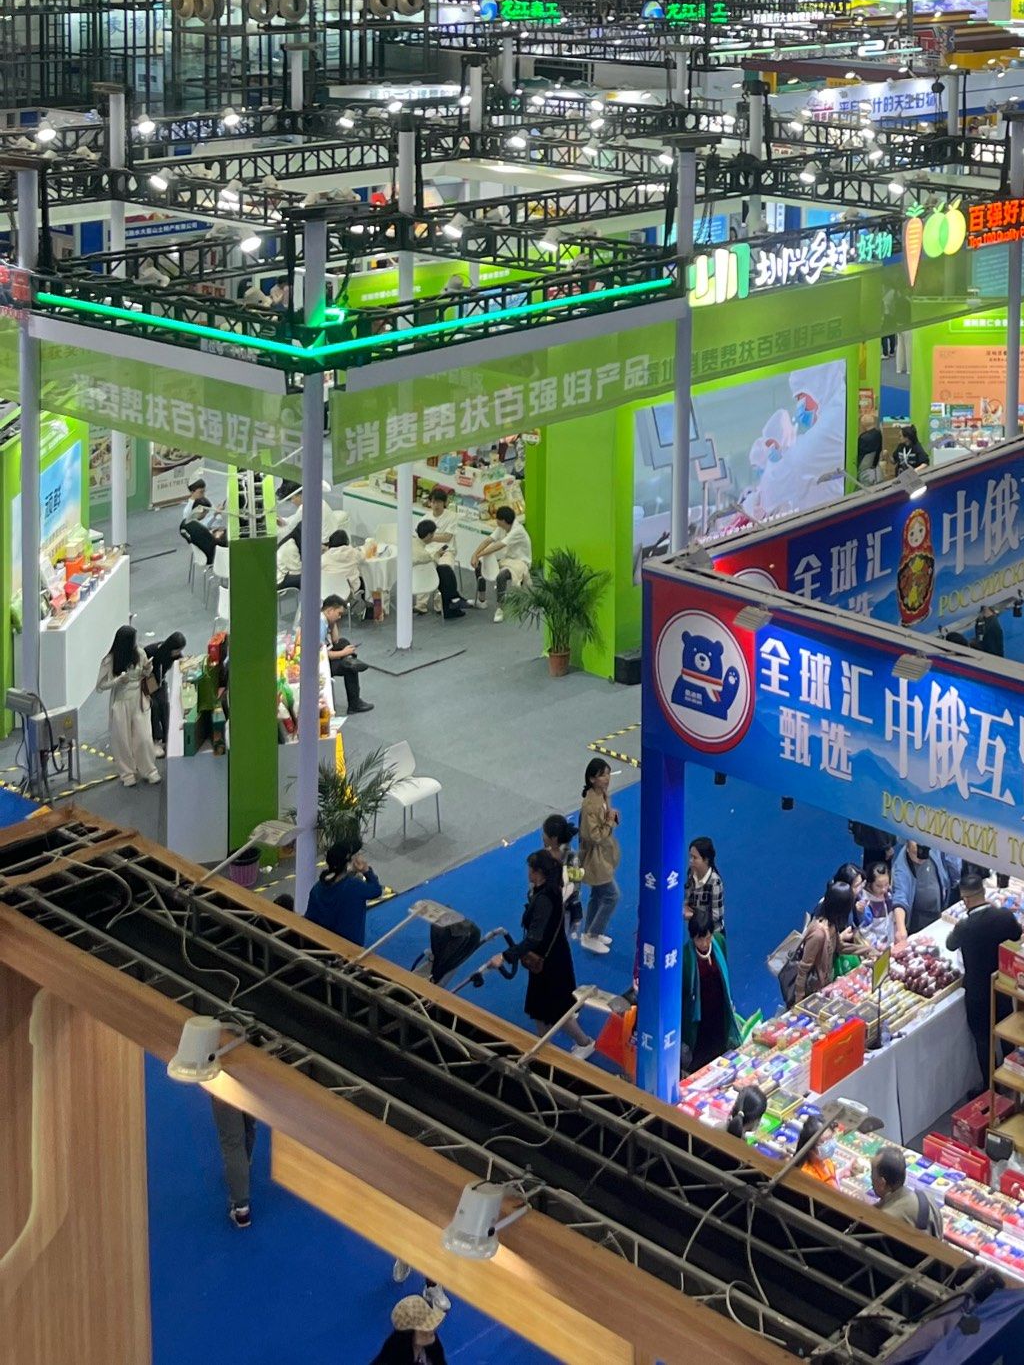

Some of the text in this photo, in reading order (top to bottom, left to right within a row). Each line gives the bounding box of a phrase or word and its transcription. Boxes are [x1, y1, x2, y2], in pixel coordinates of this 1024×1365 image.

[345, 353, 650, 466] 消费帮扶百强好产品
[794, 525, 893, 601] 全球汇
[759, 636, 874, 726] 全球汇
[778, 705, 853, 782] 甄选
[881, 789, 999, 860] РОССИЙСКИЙ
